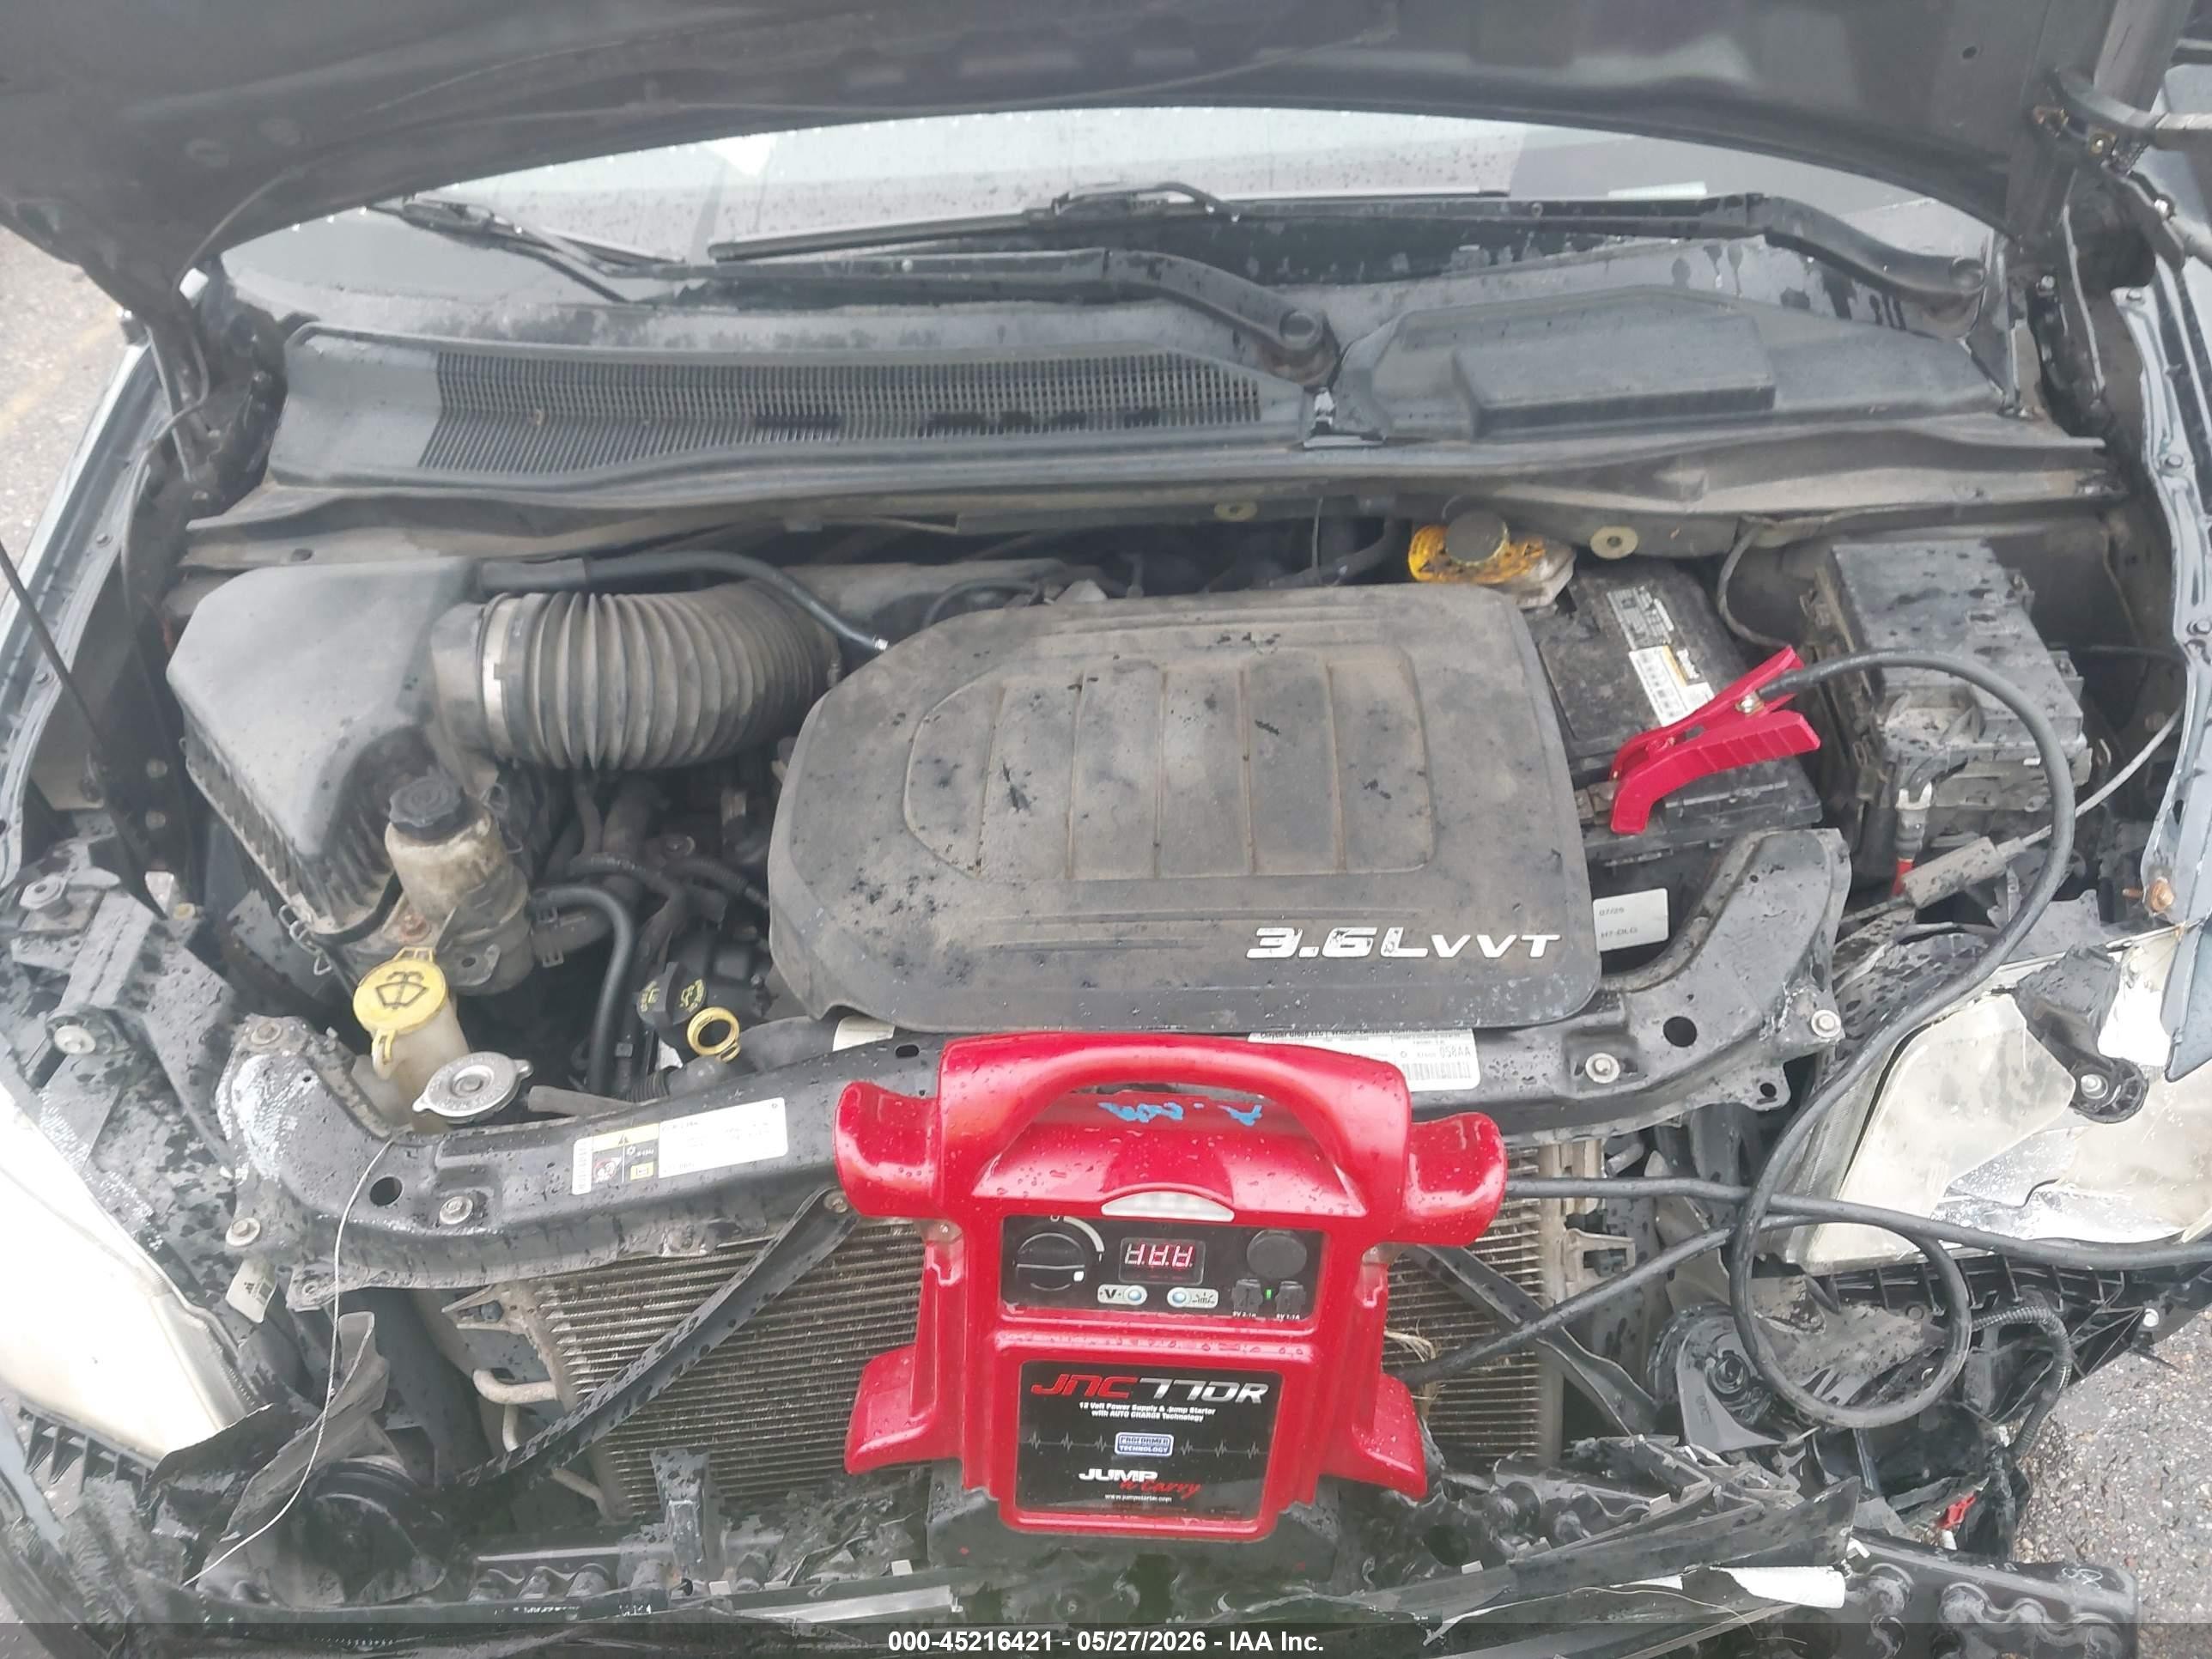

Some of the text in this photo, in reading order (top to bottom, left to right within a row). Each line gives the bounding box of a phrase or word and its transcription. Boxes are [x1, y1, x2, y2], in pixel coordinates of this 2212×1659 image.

[1247, 927, 1561, 958] 3.6L VVT
[1106, 1402, 1131, 1411] Power
[1079, 1468, 1158, 1482] JUMP
